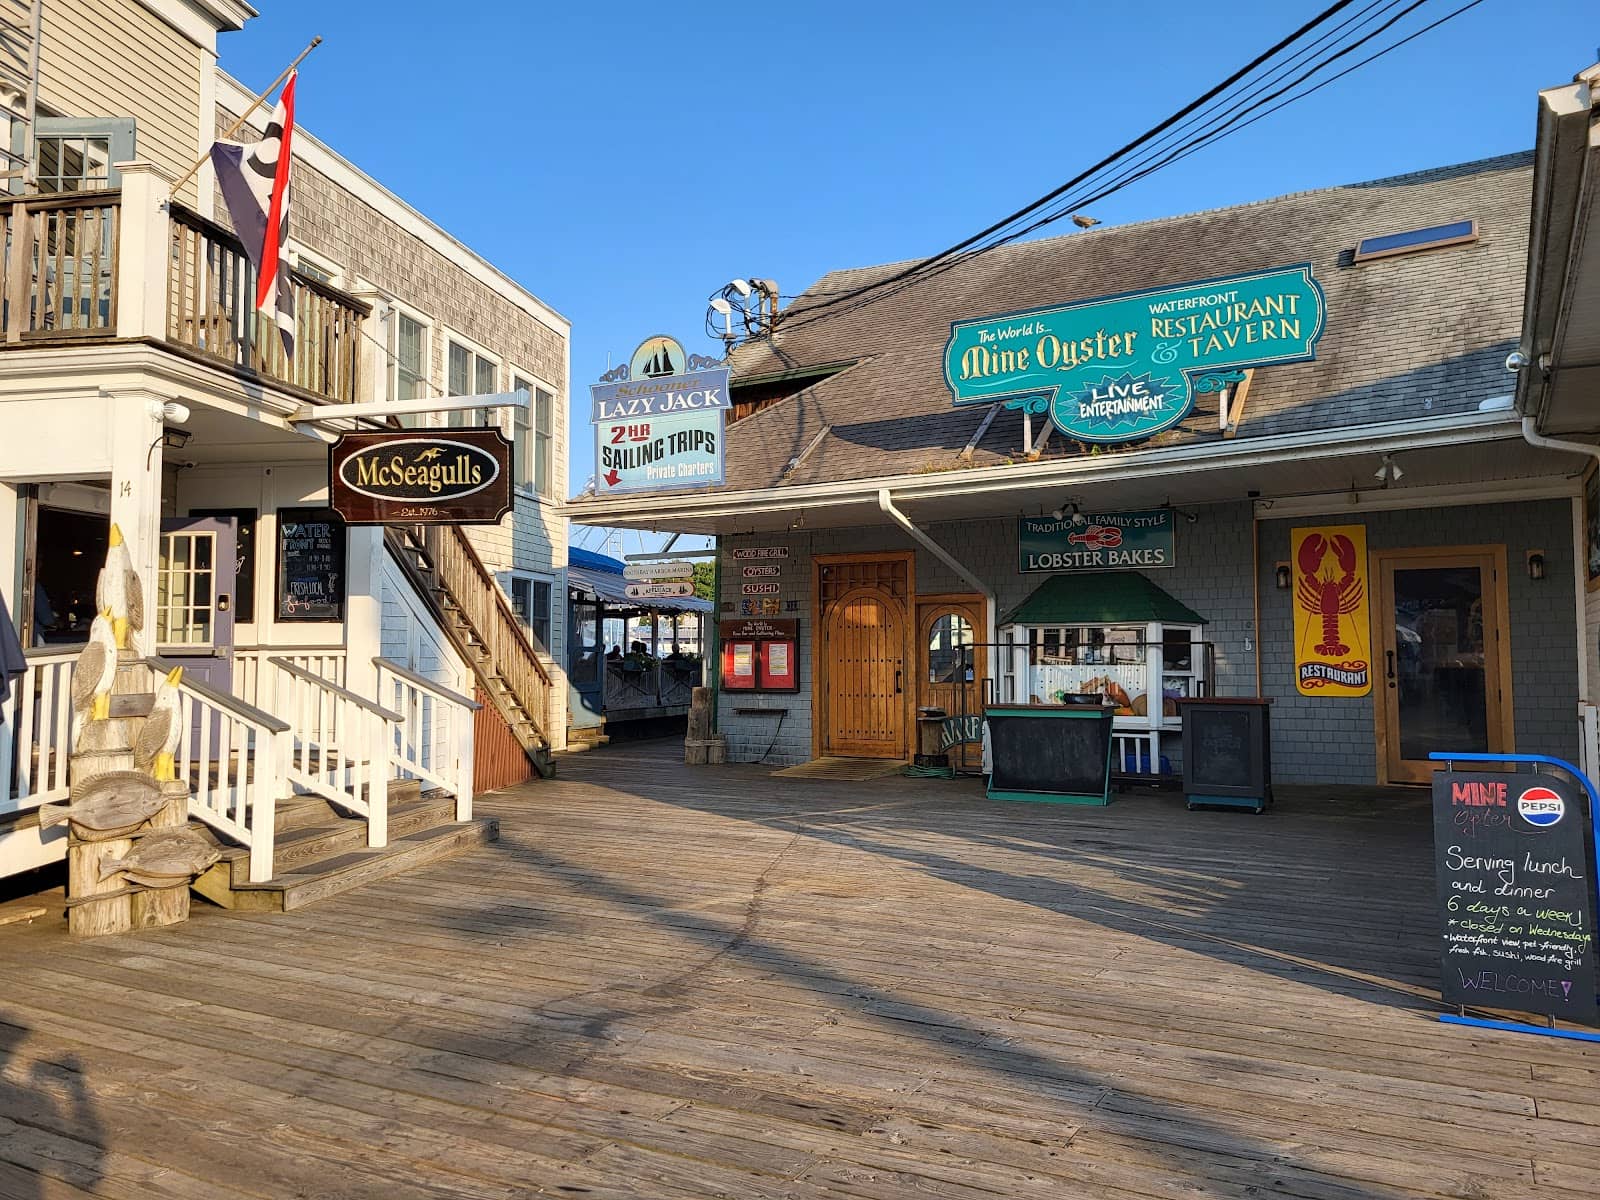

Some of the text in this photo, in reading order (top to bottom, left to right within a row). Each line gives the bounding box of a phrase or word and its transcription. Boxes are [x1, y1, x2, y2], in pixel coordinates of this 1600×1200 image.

[1149, 291, 1238, 314] WATERFRONT
[1151, 294, 1300, 338] RESTAURANT
[978, 330, 995, 343] The
[997, 323, 1032, 340] World
[1151, 318, 1300, 364] & TAVERN
[959, 329, 1137, 380] Mine Oyster
[1092, 382, 1146, 400] LIVE
[599, 389, 720, 418] LAZY JACK
[1080, 394, 1164, 419] ENTERTAINMENT
[611, 423, 650, 444] 2 HR
[603, 430, 715, 470] SAILING TRIPS
[356, 454, 481, 492] McSeagulls
[647, 462, 714, 480] Private Charters
[120, 480, 132, 497] 14
[1026, 513, 1167, 532] TRADITIONAL FAMILY STYLE
[736, 549, 757, 557] WOOD
[1028, 549, 1165, 569] LOBSTER BAKES
[747, 567, 777, 576] OYSTERS
[746, 584, 776, 593] SUSHI
[1301, 664, 1367, 685] RESTAURANT
[1452, 782, 1507, 806] MINE
[1521, 802, 1560, 812] PEPSI
[1446, 845, 1583, 885] Serving lunch
[1451, 879, 1556, 899] and dinner
[1447, 895, 1461, 911] 6
[1466, 900, 1510, 924] days
[1516, 906, 1532, 917] a
[1509, 926, 1523, 935] on
[1529, 923, 1591, 953] Wednesdays
[1448, 944, 1470, 954] fresh
[1525, 954, 1546, 962] wood
[1546, 953, 1563, 964] fire
[1564, 958, 1581, 970] grill
